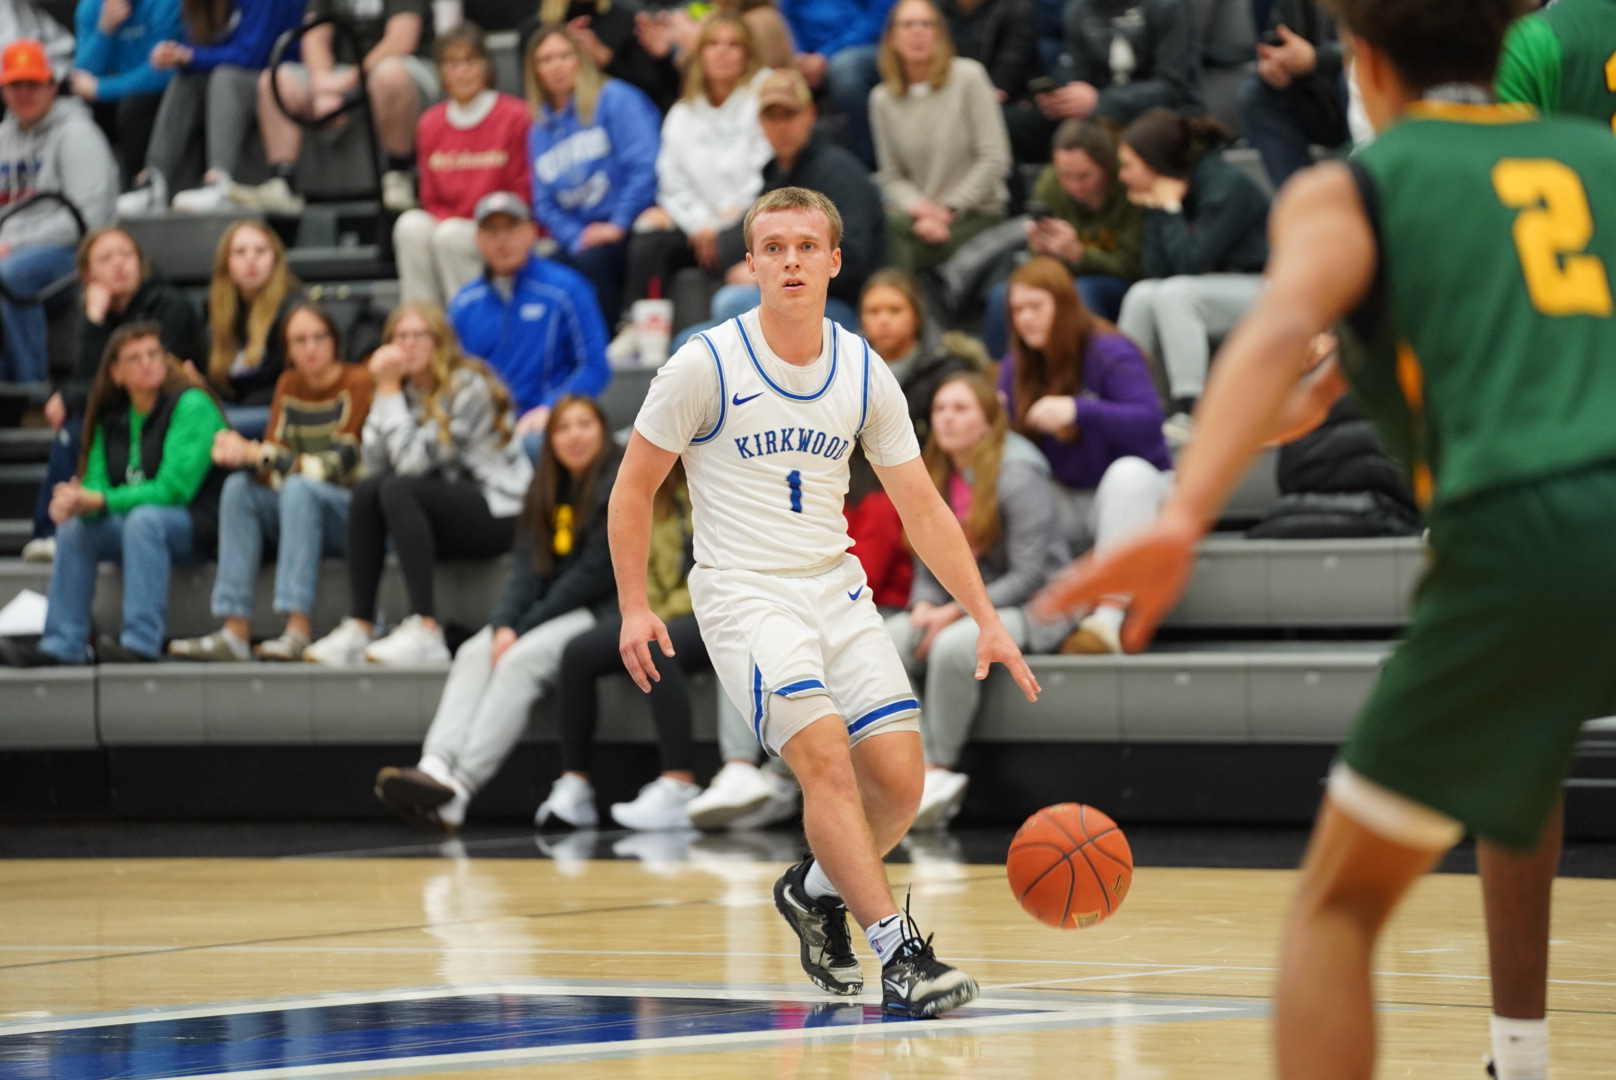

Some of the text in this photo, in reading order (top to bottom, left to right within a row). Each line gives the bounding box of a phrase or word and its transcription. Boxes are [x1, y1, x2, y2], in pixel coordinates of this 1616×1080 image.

[1491, 157, 1614, 318] 2
[734, 427, 849, 460] KIRKWOOD
[786, 469, 803, 514] 1
